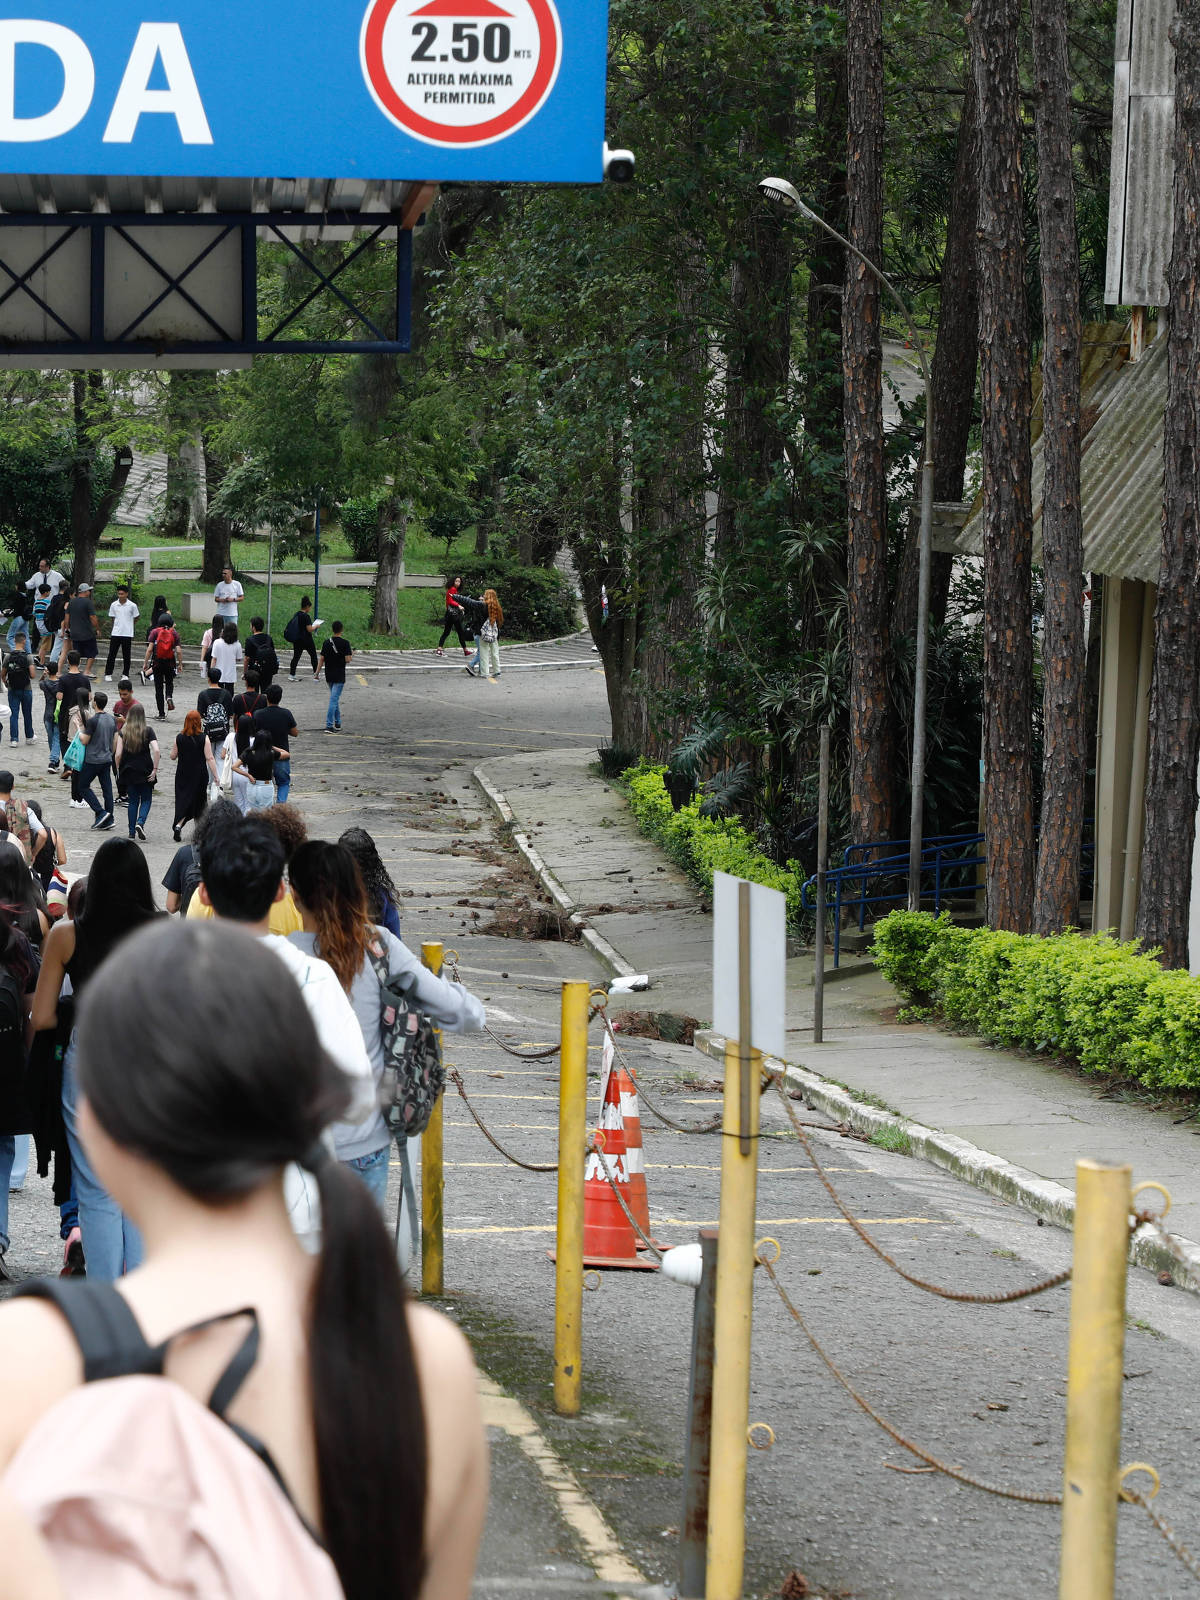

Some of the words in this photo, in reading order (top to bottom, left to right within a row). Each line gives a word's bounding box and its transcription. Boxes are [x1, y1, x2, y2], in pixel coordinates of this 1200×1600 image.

[411, 22, 511, 63] 2.50
[514, 49, 532, 59] MTS
[407, 73, 455, 86] ALTURA
[459, 71, 513, 87] MÁXIMA
[424, 91, 495, 105] PERMITIDA
